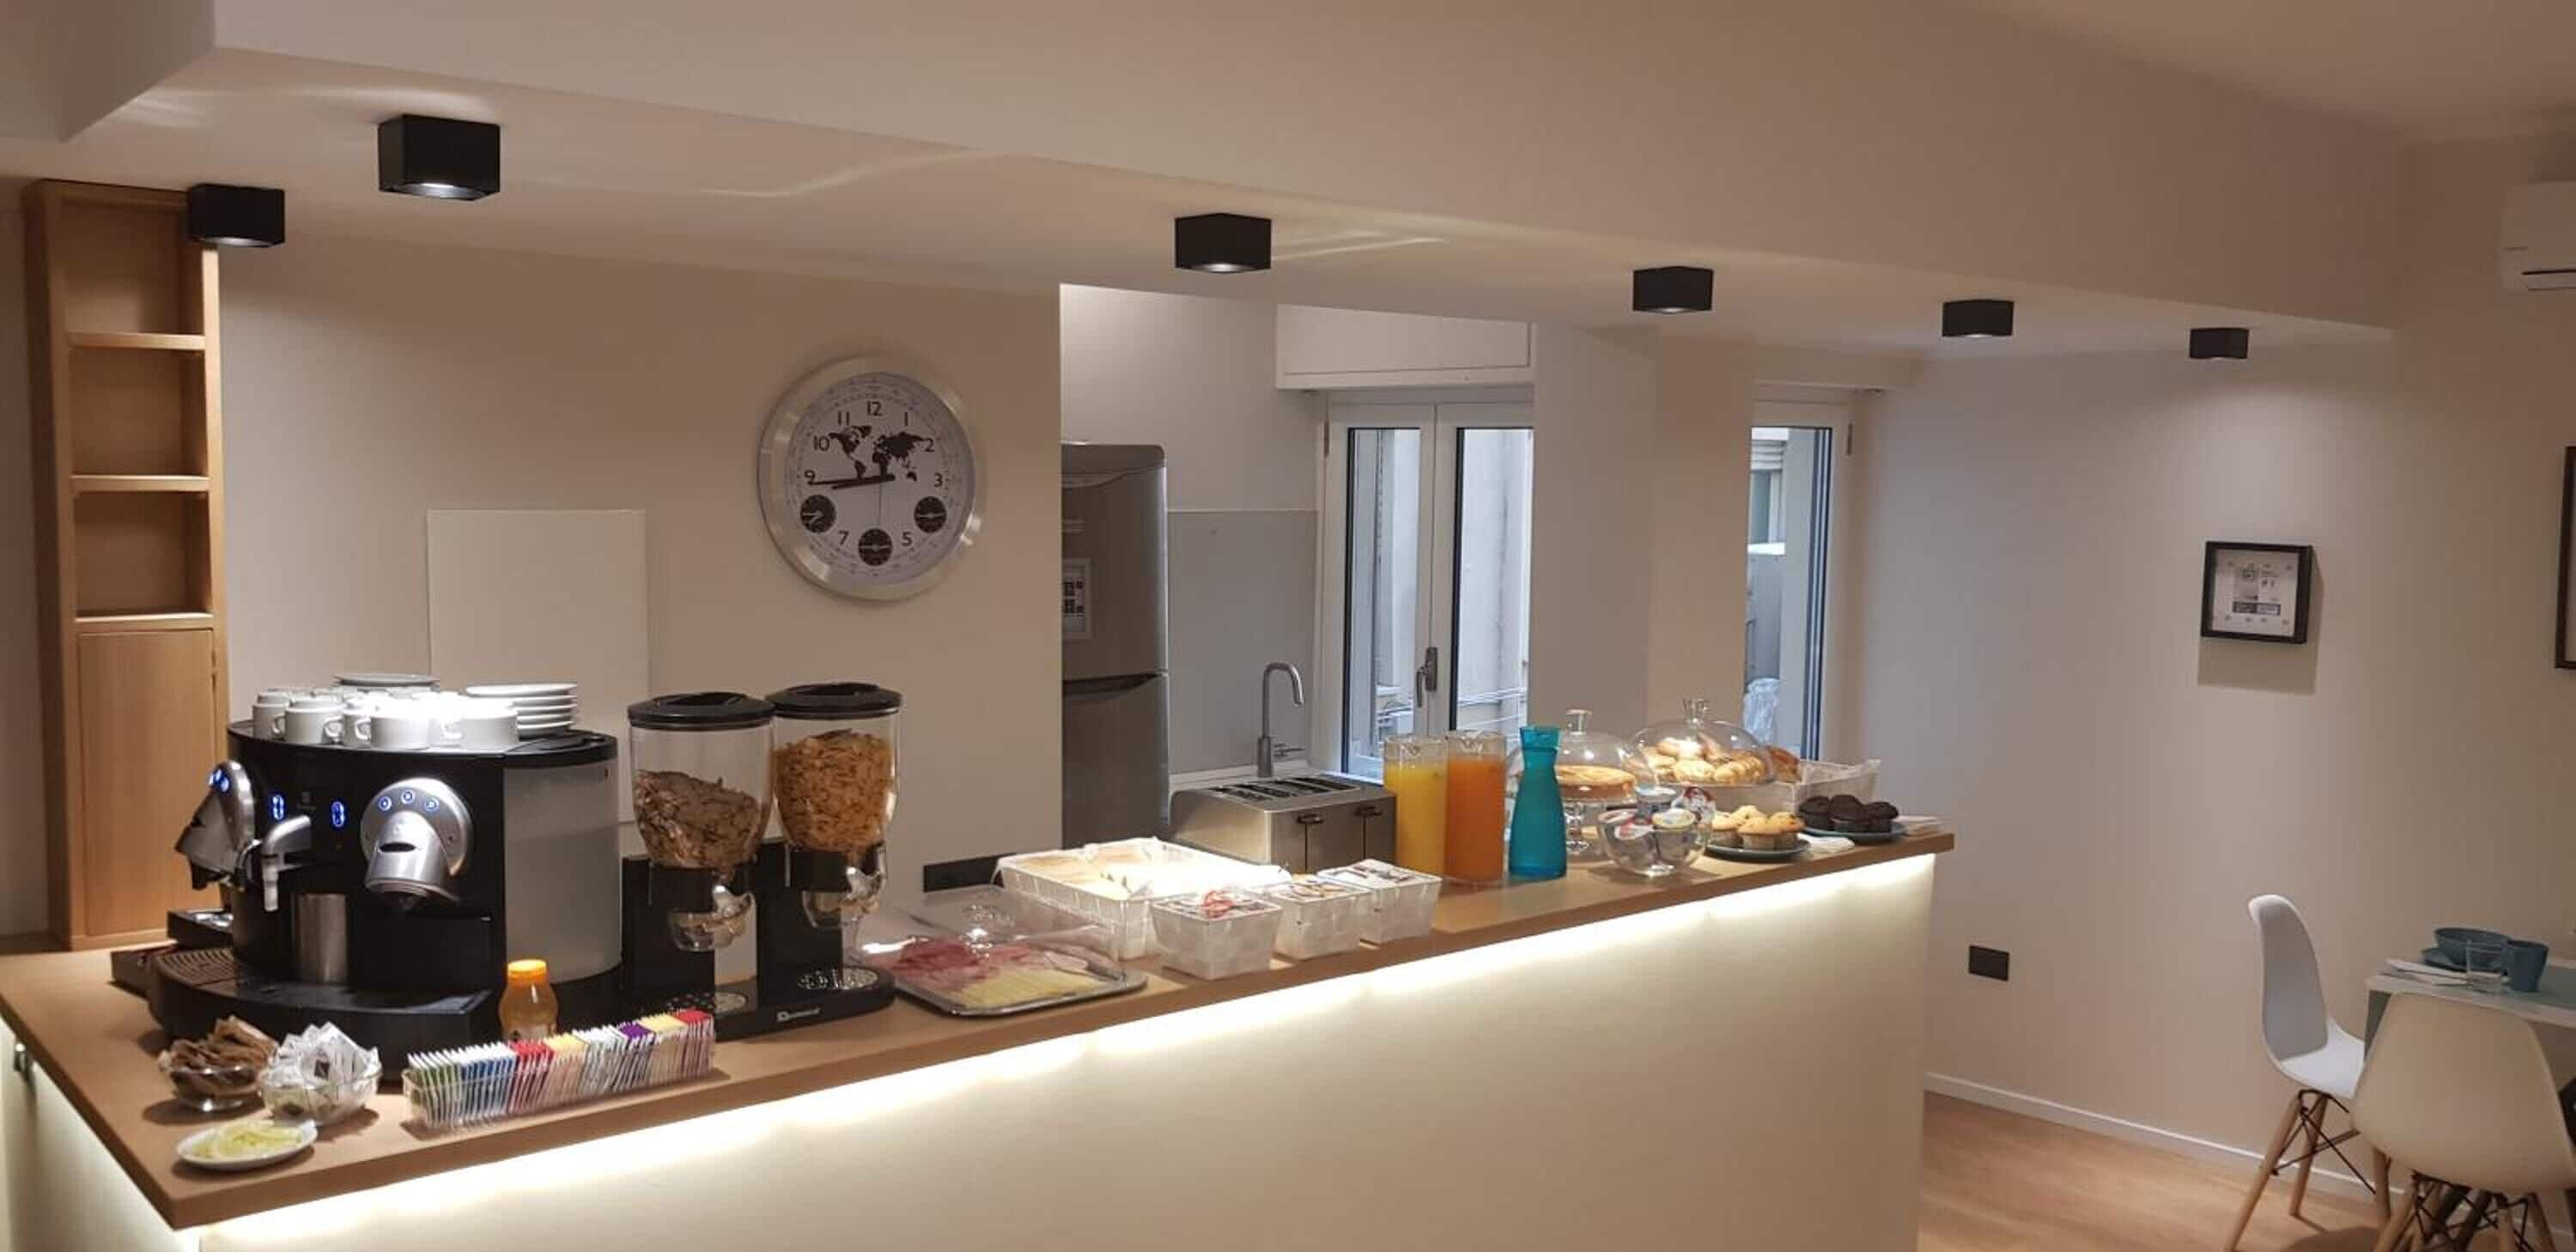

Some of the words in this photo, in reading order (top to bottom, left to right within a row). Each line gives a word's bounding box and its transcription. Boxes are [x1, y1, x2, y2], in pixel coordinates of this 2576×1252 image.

[866, 401, 883, 416] 12
[837, 411, 850, 425] 11
[904, 412, 908, 427] 1
[813, 435, 830, 451] 10
[925, 438, 934, 453] 2
[804, 470, 816, 484] 9
[934, 473, 943, 487] 3
[838, 531, 848, 545] 7
[902, 532, 912, 546] 5
